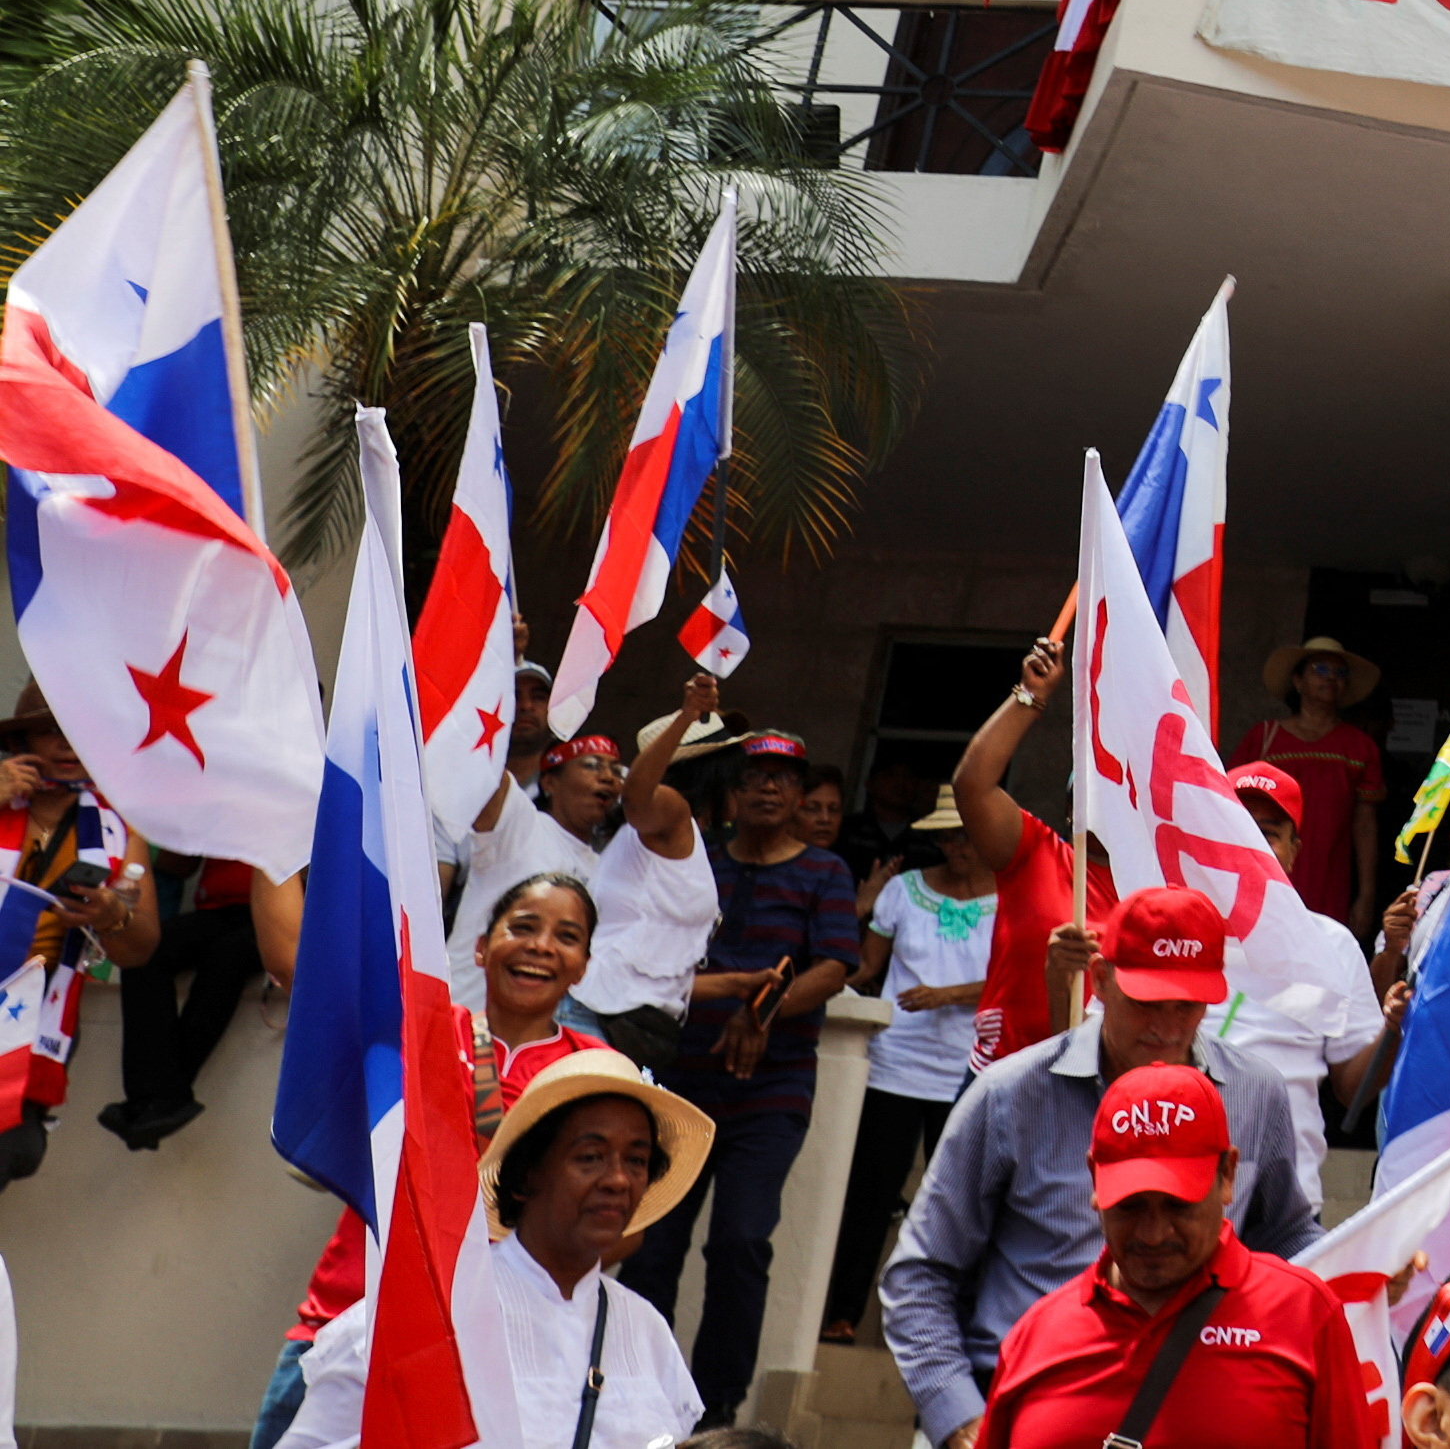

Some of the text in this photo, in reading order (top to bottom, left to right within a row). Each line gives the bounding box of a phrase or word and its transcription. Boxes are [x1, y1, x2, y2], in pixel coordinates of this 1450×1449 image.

[1236, 775, 1277, 791] CNTP
[1153, 938, 1203, 958] CNTP
[1112, 1099, 1195, 1134] CNTP
[1200, 1325, 1261, 1348] CNTP
